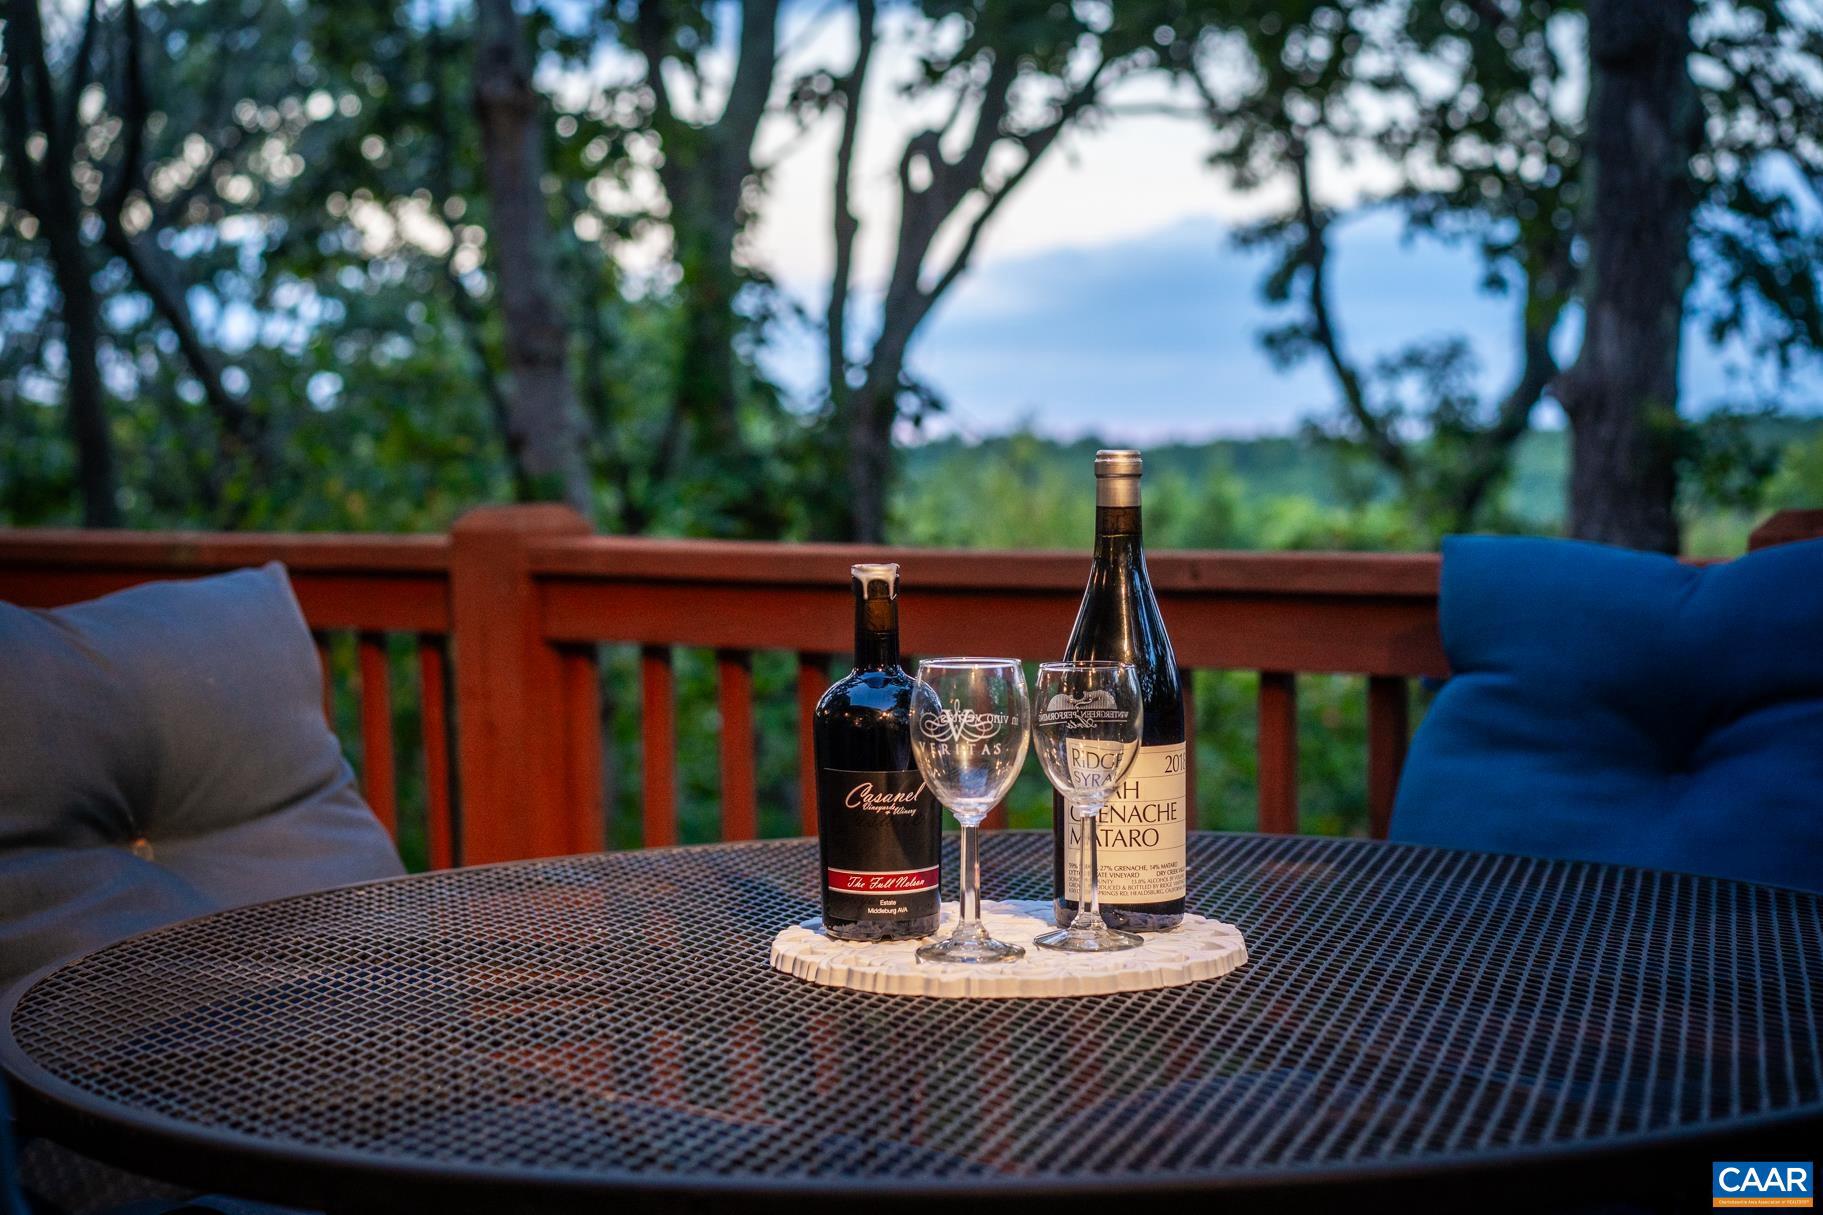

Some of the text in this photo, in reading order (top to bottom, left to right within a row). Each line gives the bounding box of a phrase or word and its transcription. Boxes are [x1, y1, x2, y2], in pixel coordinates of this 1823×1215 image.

[919, 742, 1002, 756] VERITAS
[845, 782, 928, 808] Casanel
[1070, 802, 1177, 824] GENACHE
[847, 876, 925, 889] The Full Nelson
[867, 907, 897, 915] Middleburg
